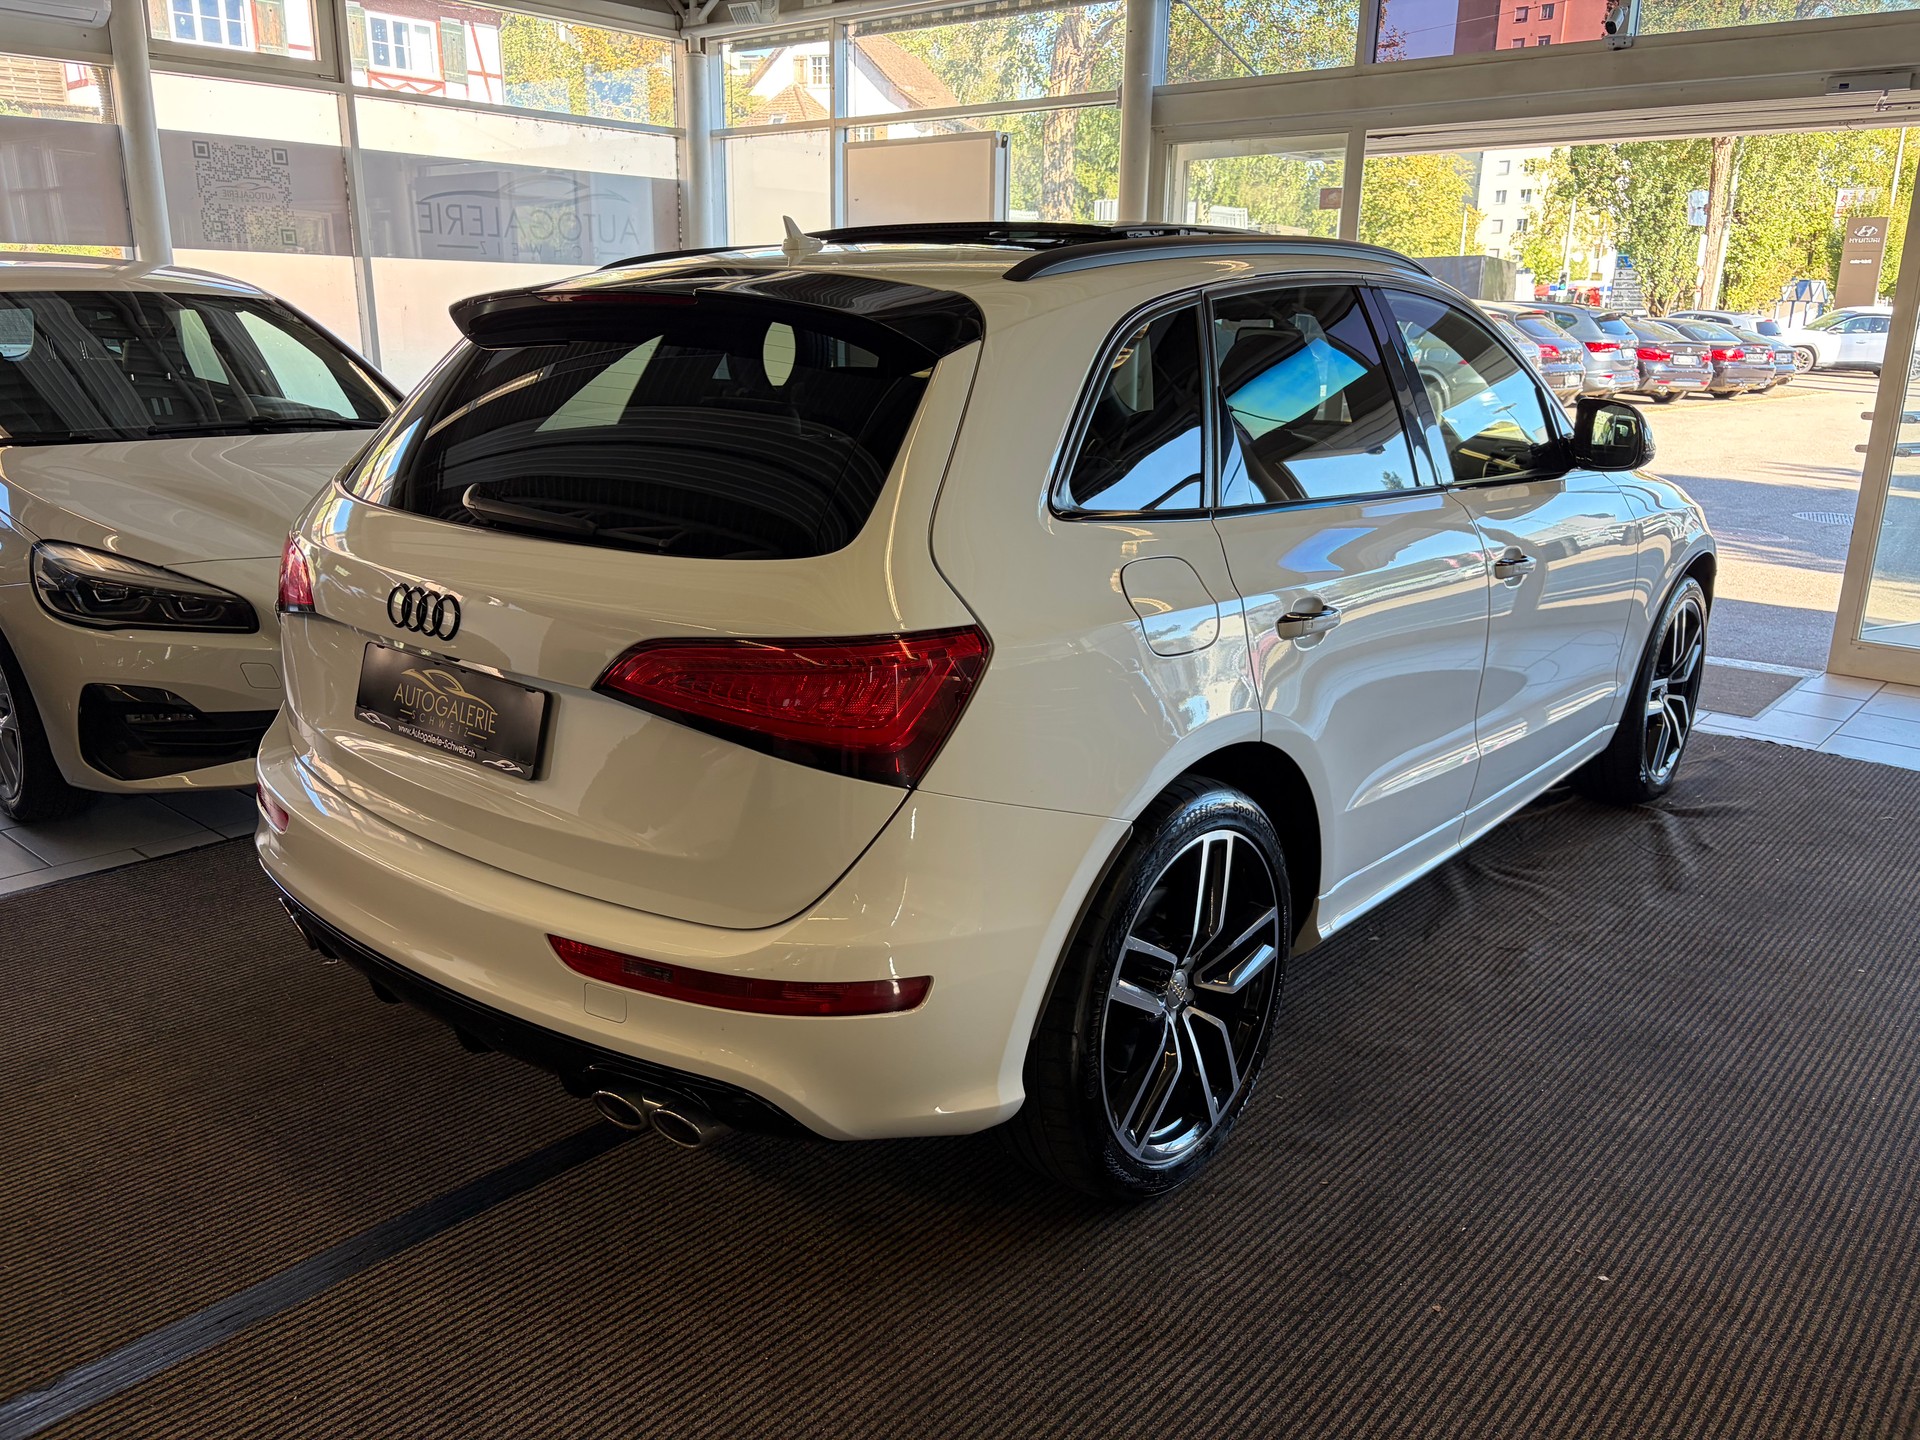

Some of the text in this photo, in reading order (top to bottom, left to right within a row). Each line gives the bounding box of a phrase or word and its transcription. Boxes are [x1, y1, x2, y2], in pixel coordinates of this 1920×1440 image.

[393, 683, 498, 734] AUTOGALERIE
[411, 710, 469, 737] SCHWEIZ
[398, 724, 476, 759] www.Autogalerie-Schweiz.ch
